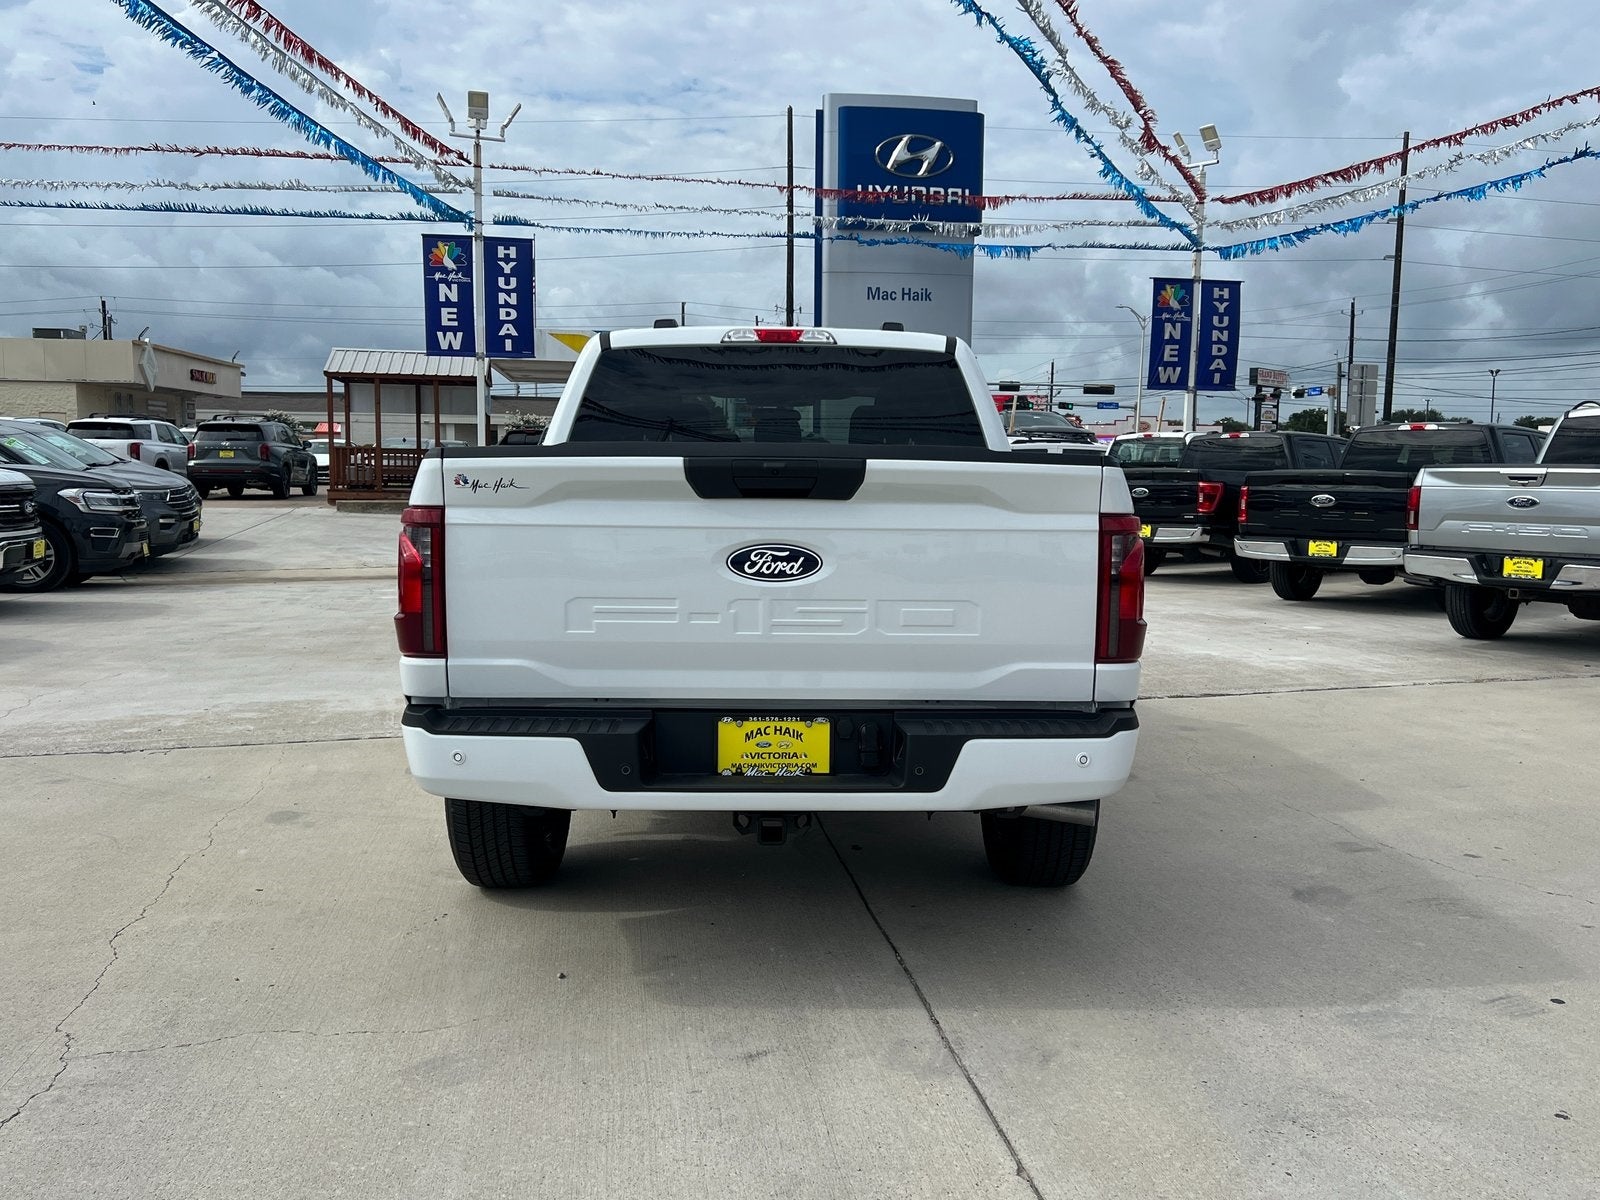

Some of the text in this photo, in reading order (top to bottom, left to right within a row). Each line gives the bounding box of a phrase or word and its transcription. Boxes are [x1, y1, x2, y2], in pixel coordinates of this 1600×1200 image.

[497, 245, 519, 352] HYUNDAI
[866, 286, 932, 302] Mac Haik
[436, 283, 463, 350] NEW
[1209, 287, 1230, 385] HYUNDAI
[1158, 322, 1181, 384] NEW
[470, 477, 529, 494] Mac Haik
[1461, 523, 1589, 539] F-150
[744, 550, 804, 574] Ford
[565, 596, 981, 636] F-150
[744, 725, 804, 743] MAC HAIK
[750, 752, 799, 760] VICTORIA
[744, 766, 806, 777] Mac Haik
